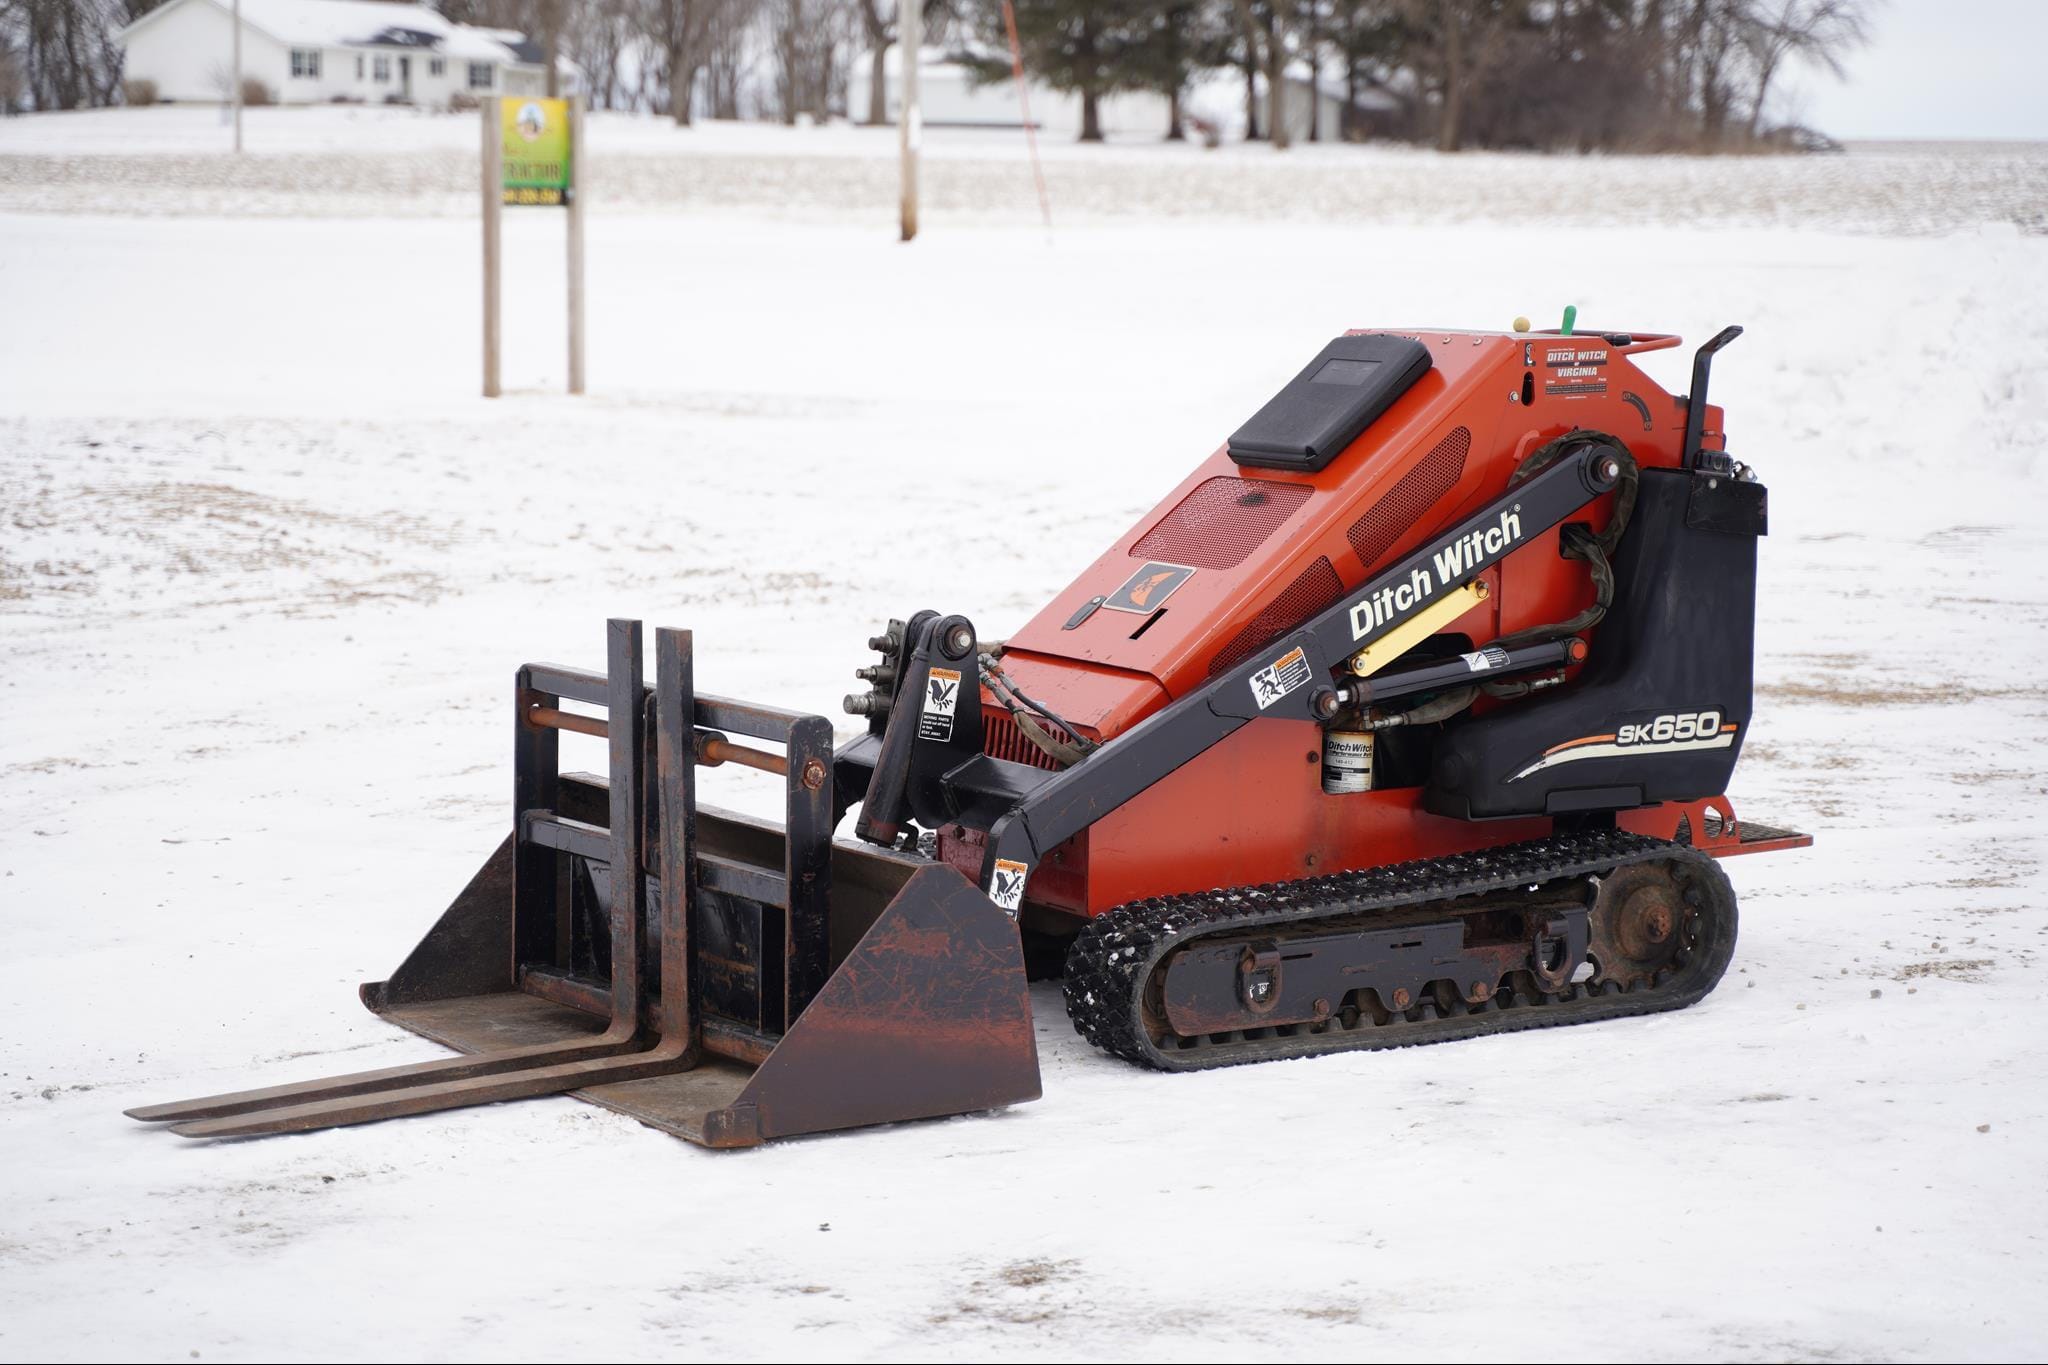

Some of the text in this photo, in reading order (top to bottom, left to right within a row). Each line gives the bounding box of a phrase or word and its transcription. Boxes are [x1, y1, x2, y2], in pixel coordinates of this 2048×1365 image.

[1547, 350, 1607, 362] DITCH WITCH
[1557, 367, 1597, 377] VIRGINIA
[1350, 510, 1522, 642] Ditch Witch
[1617, 711, 1721, 744] SK650
[1328, 740, 1352, 752] Ditch
